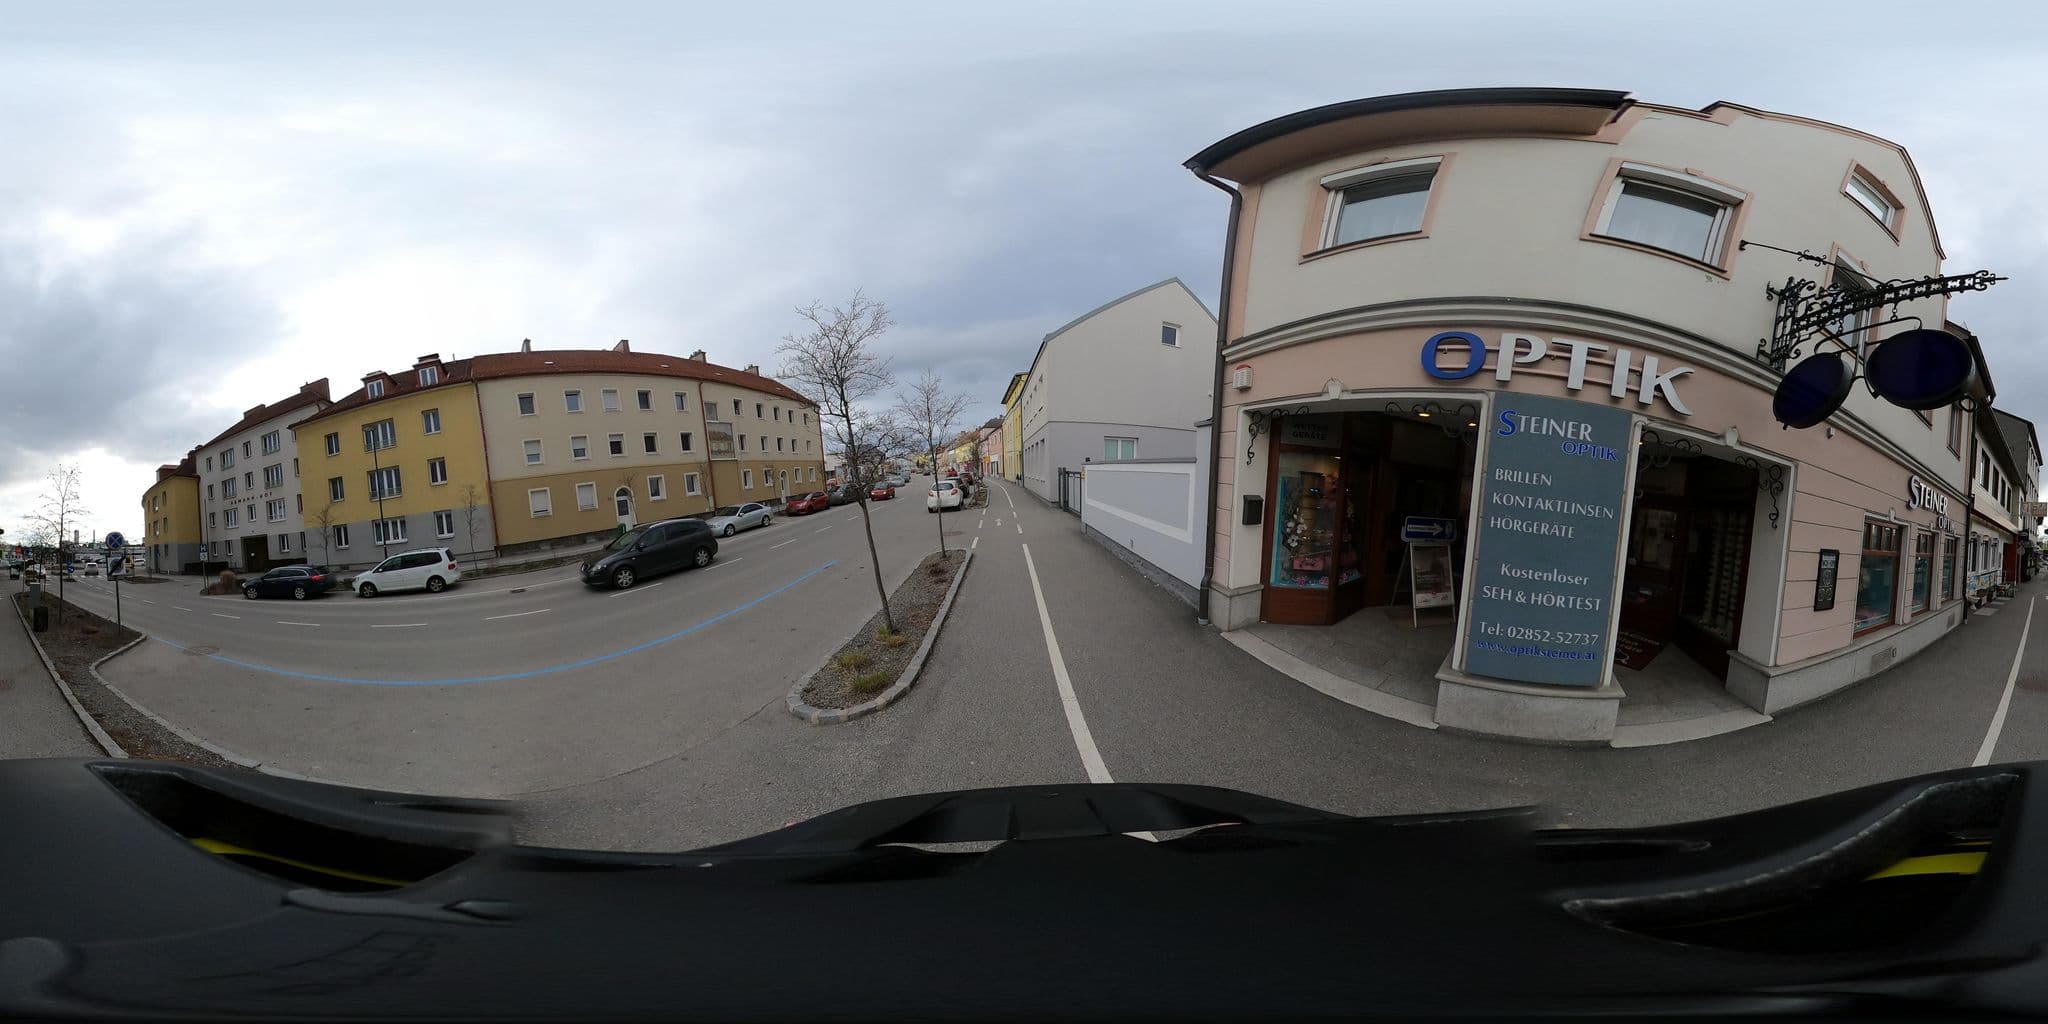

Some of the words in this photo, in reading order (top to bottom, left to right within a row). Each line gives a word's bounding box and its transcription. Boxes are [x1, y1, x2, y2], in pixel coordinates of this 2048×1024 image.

[1421, 331, 1695, 416] OPTIK
[1497, 410, 1592, 441] STEINER
[1561, 441, 1618, 461] OPTIK
[1495, 468, 1552, 486] BRILLEN
[1492, 492, 1614, 519] KONTAKTLINSEN
[1909, 475, 1948, 517] STEINER
[1490, 515, 1575, 539] HÖRGERÄTE
[1500, 563, 1590, 585] Kostenloser
[1482, 585, 1512, 600] SEH
[1515, 591, 1527, 603] &
[1530, 591, 1601, 611] HÖRTEST
[1479, 621, 1504, 636] Tel:
[1507, 626, 1599, 646] 02852-52737
